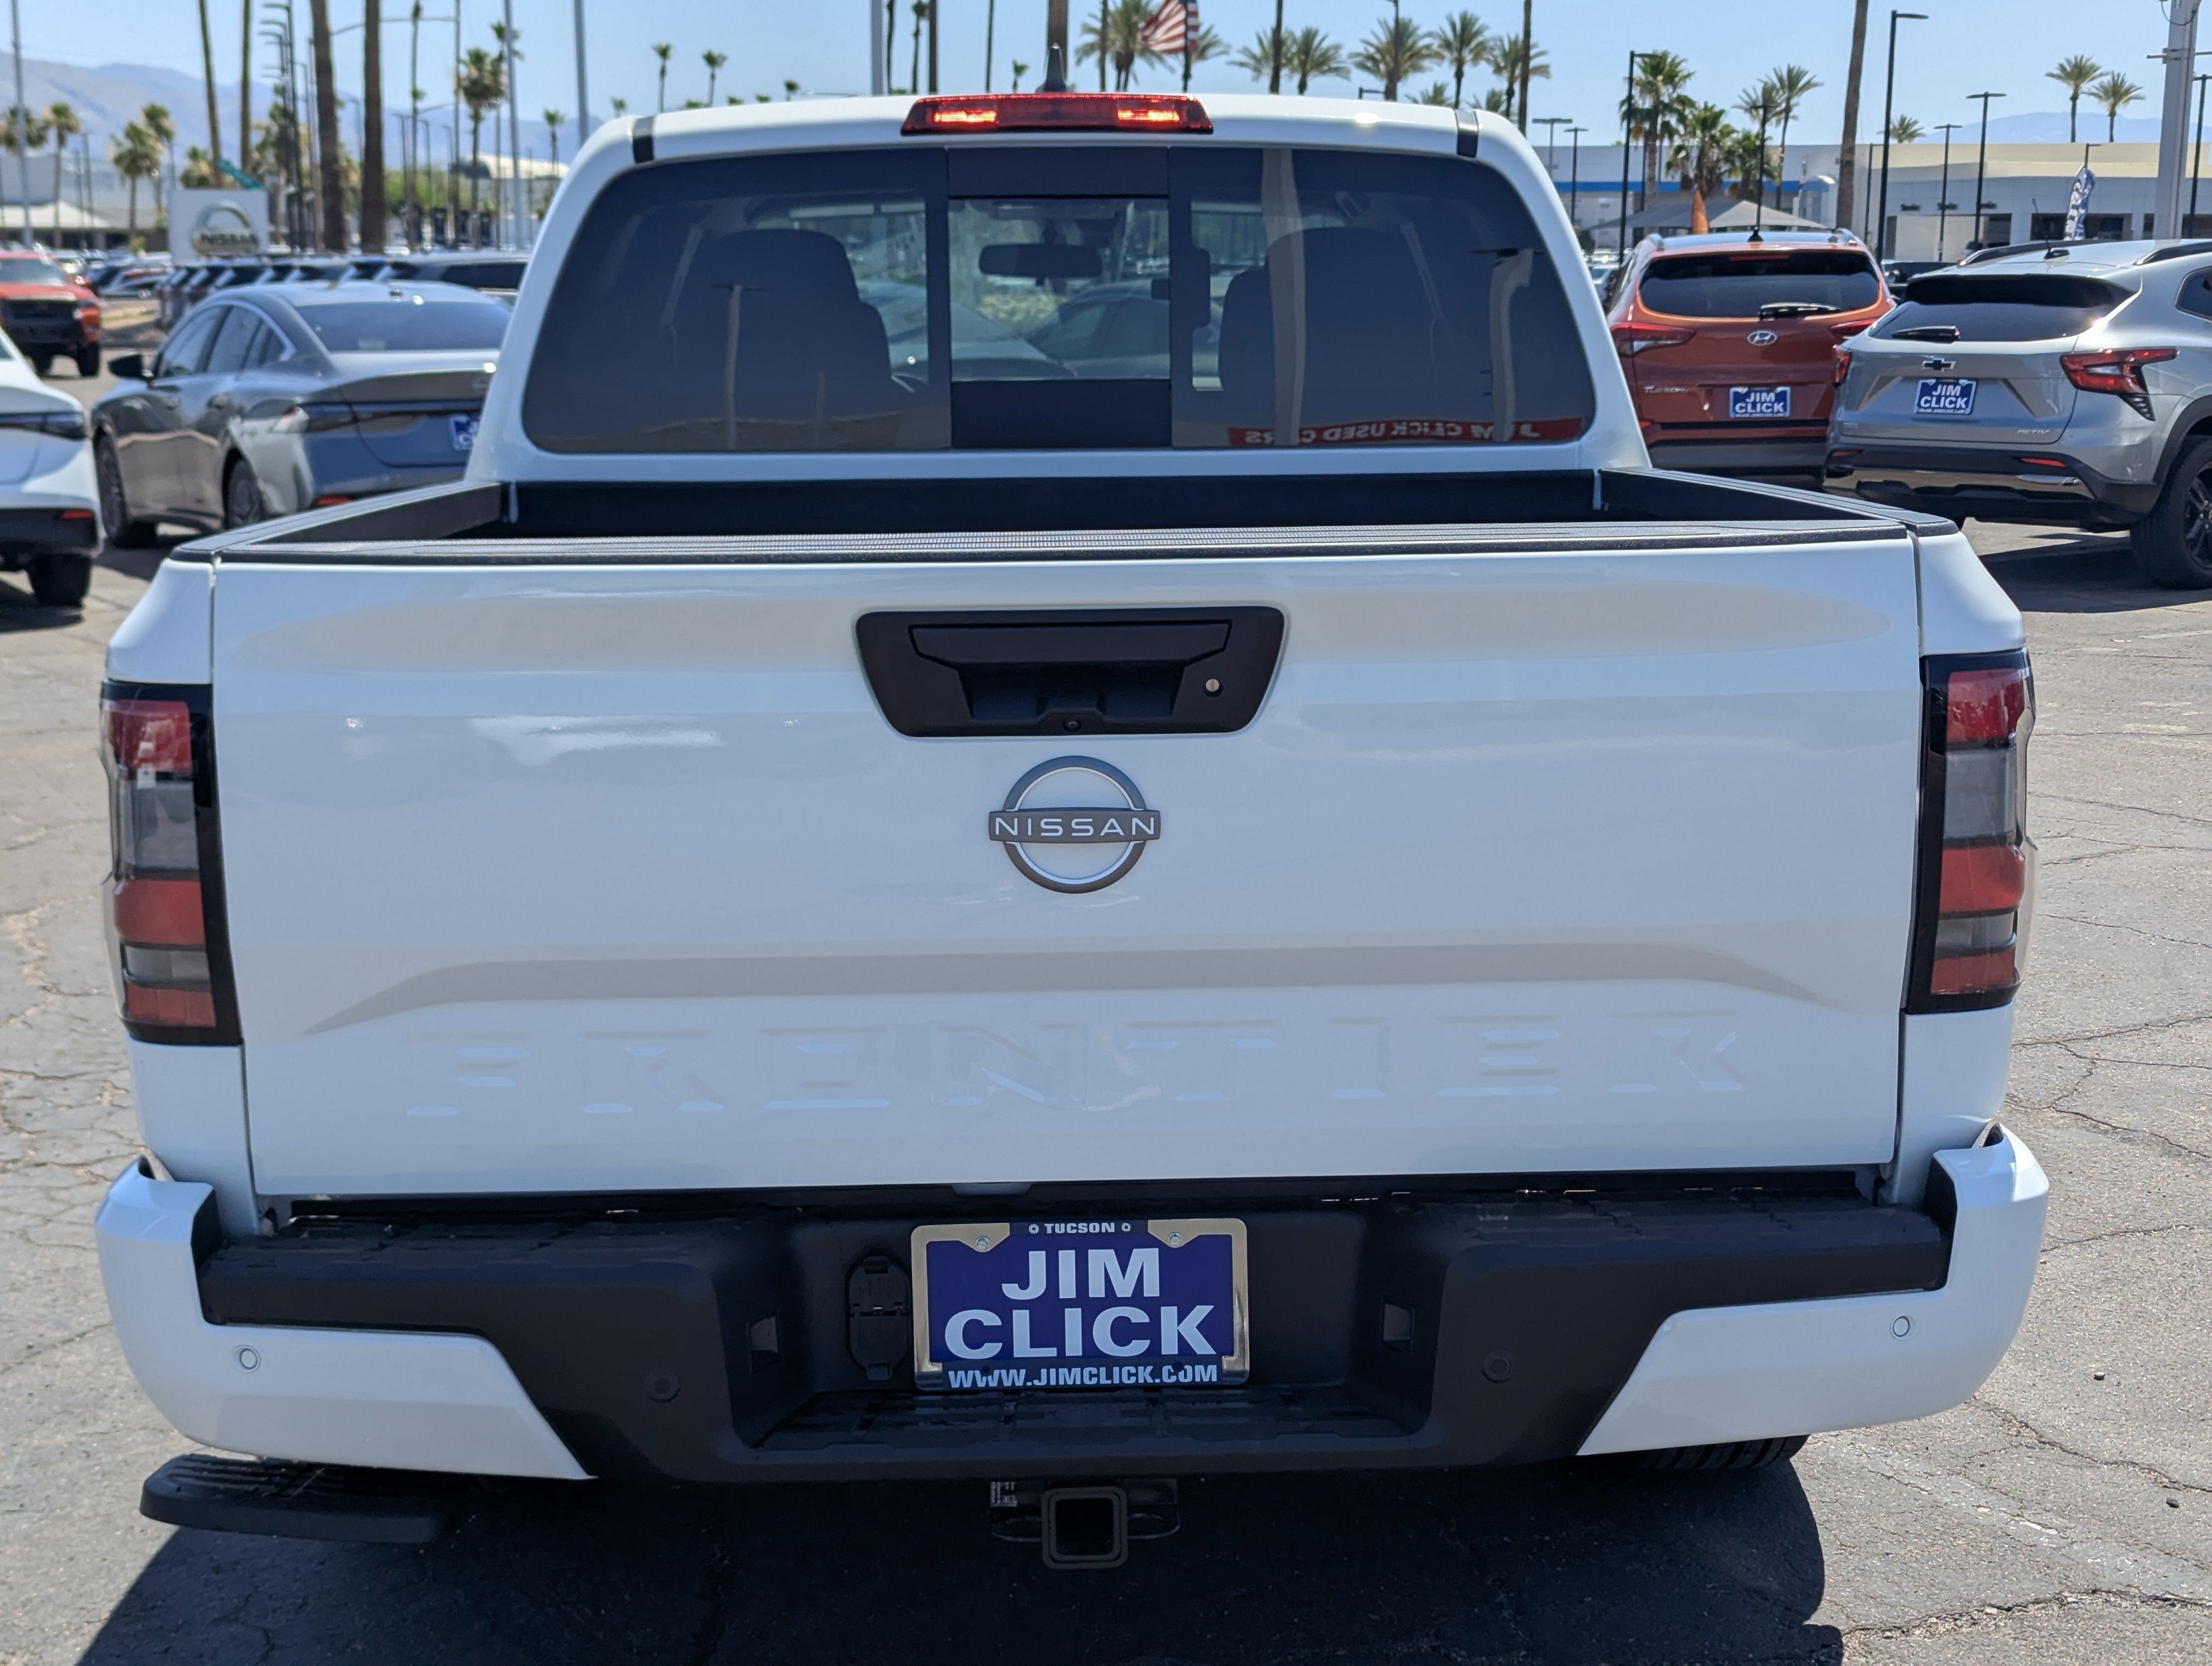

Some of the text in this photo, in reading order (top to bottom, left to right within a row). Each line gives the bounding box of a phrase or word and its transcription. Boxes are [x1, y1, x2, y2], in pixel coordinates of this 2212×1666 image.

[1746, 392, 1775, 402] JIM
[1932, 385, 1961, 396] JIM
[1735, 402, 1785, 413] CLICK
[1920, 396, 1968, 408] CLICK
[995, 817, 1154, 836] NISSAN
[404, 1010, 1747, 1115] FRONTIER
[1044, 1222, 1115, 1234] TUCSON
[1001, 1248, 1160, 1300] JIM
[944, 1305, 1216, 1360] CLICK
[948, 1364, 1218, 1388] WWW.JIMCLICK.COM
